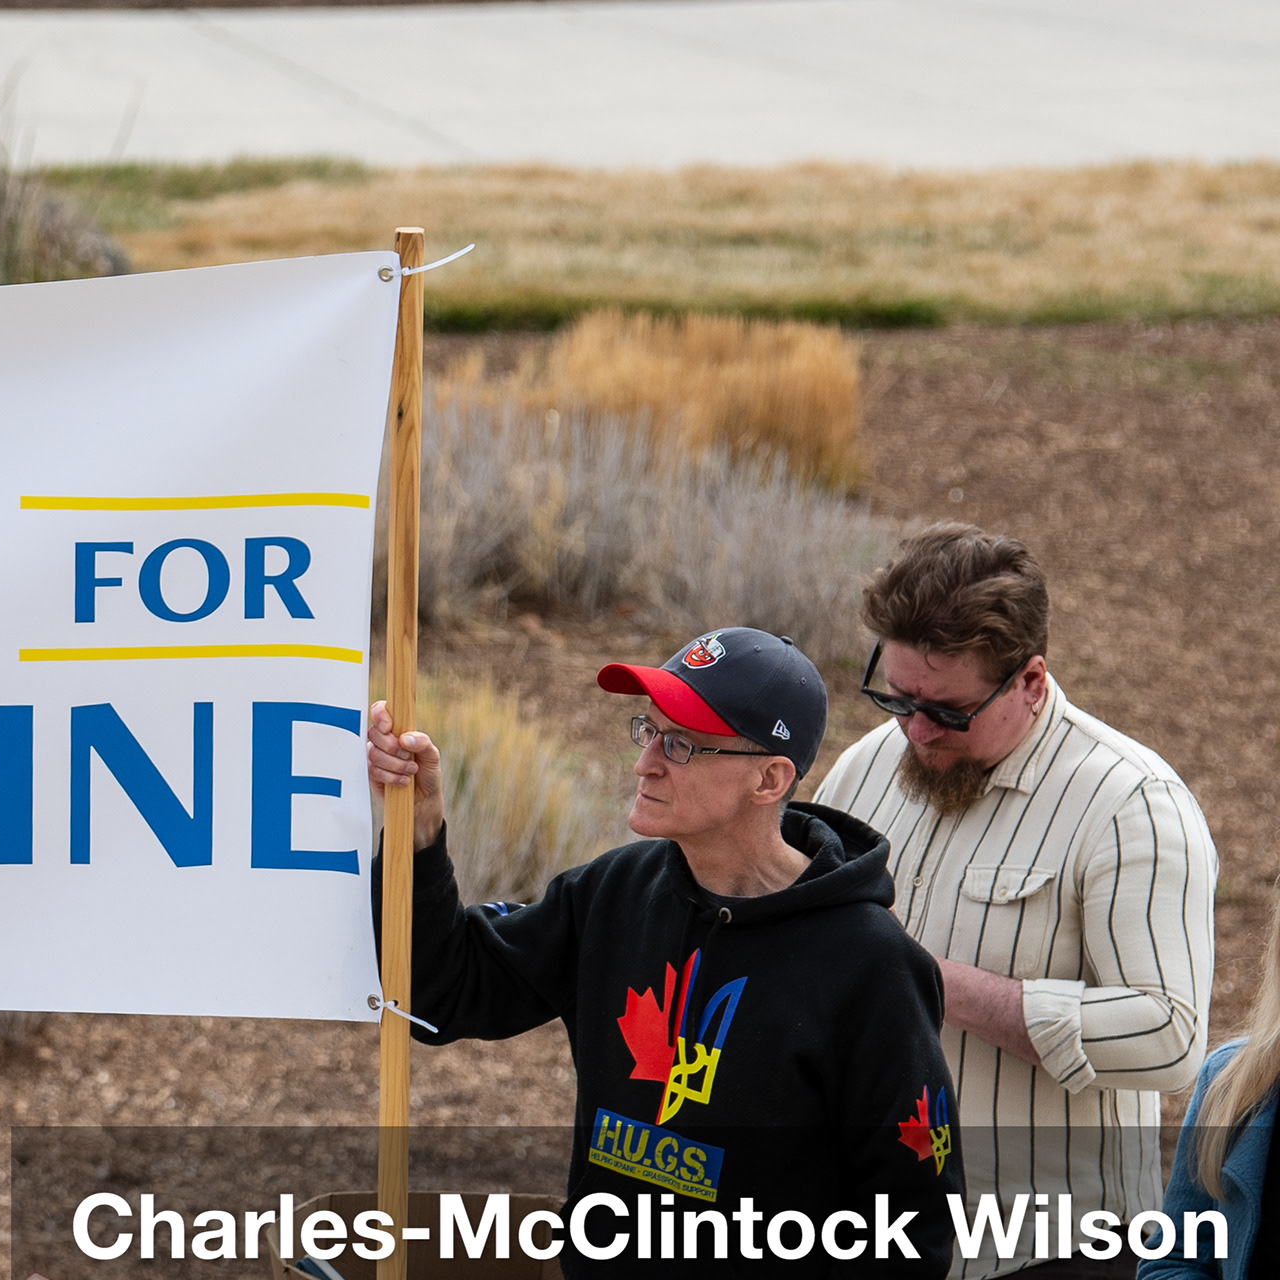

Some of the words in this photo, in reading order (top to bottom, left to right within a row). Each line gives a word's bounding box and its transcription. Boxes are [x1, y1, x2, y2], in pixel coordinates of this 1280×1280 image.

[73, 536, 316, 623] FOR
[597, 1114, 712, 1186] H.U.G.S.
[682, 1184, 715, 1199] SUPPORT
